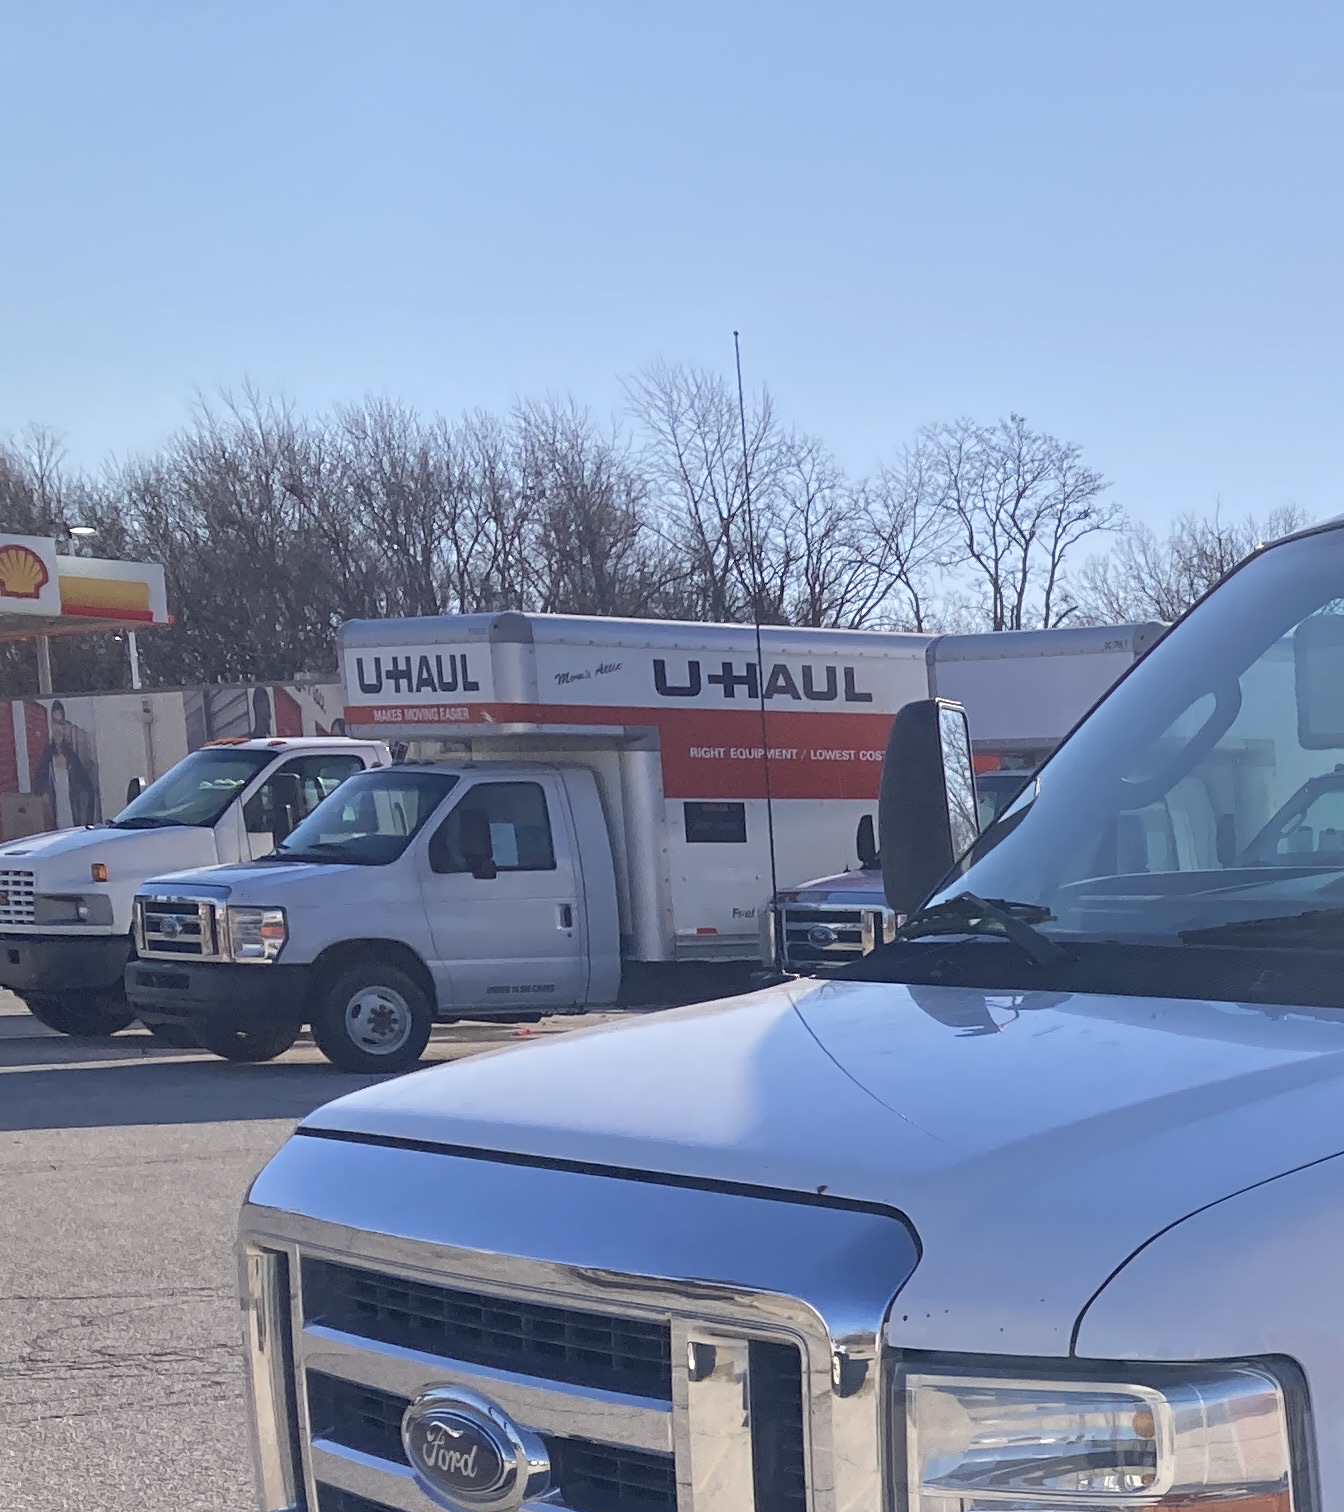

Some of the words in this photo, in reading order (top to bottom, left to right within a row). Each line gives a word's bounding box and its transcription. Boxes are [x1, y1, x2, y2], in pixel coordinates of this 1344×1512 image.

[356, 654, 480, 694] U-HAUL
[653, 659, 873, 702] U-HAUL
[373, 709, 402, 721] MAKES
[404, 708, 438, 720] MOVING
[440, 706, 470, 720] EASIER
[689, 747, 725, 758] RIGHT
[730, 748, 798, 760] EQUIPMENT
[810, 749, 855, 761] LOWEST
[422, 1420, 479, 1478] Ford
